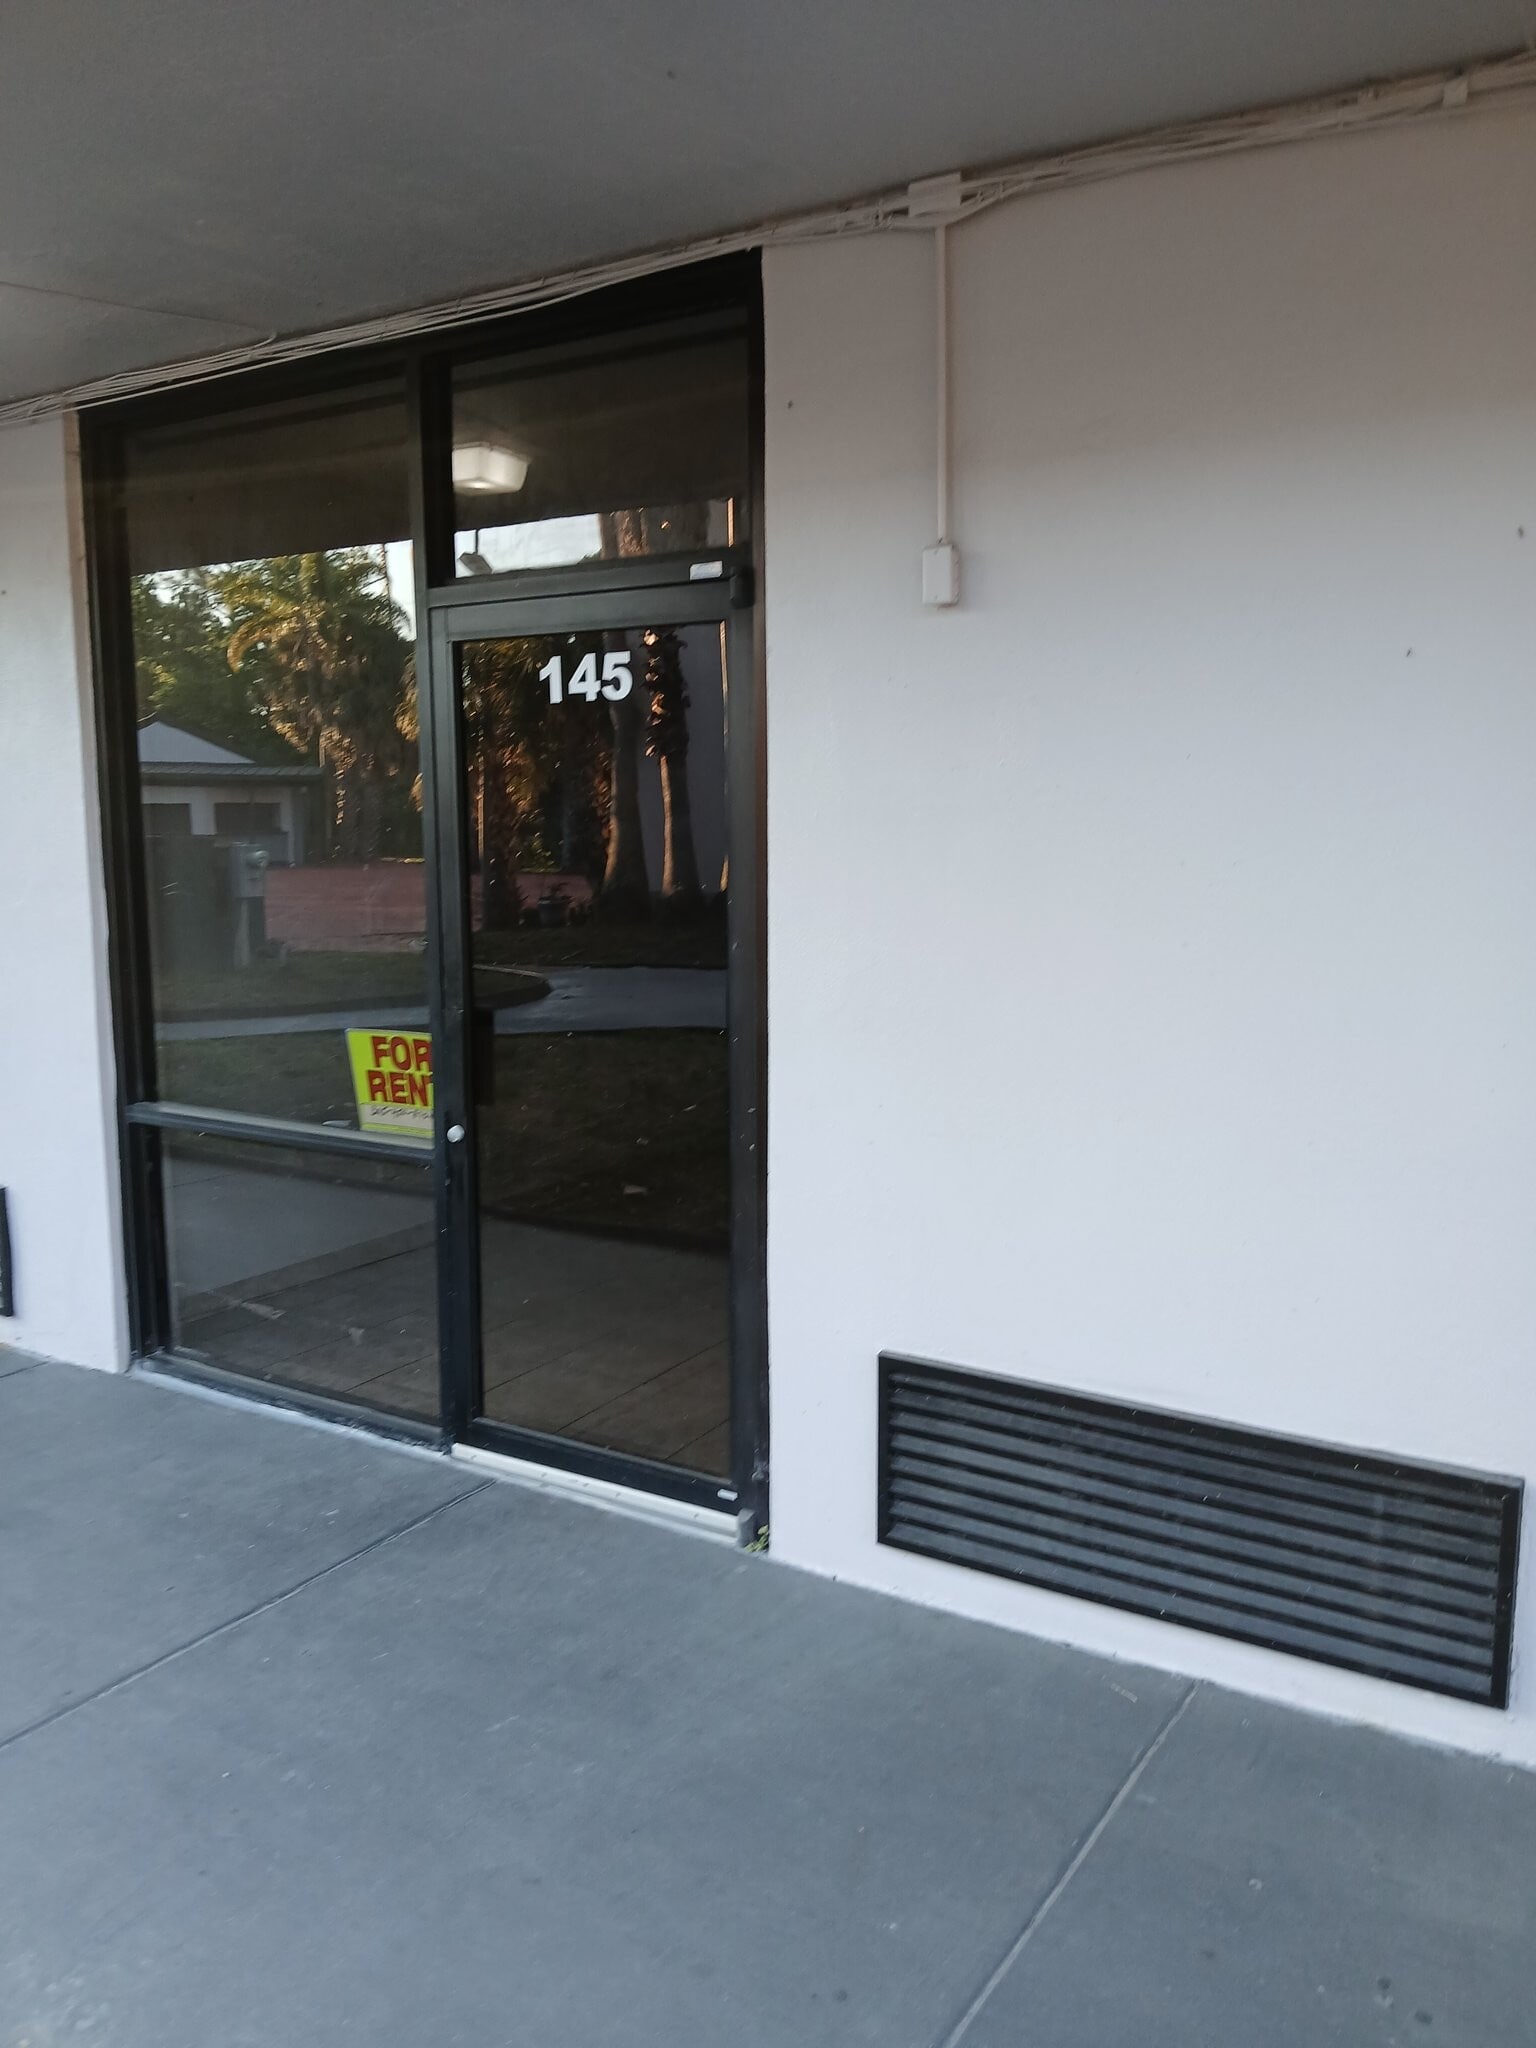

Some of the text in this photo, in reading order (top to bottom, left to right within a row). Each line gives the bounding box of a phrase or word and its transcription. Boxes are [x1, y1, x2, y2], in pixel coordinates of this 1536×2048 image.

[539, 650, 633, 705] 145
[371, 1035, 432, 1073] FOR
[367, 1070, 433, 1106] REN
